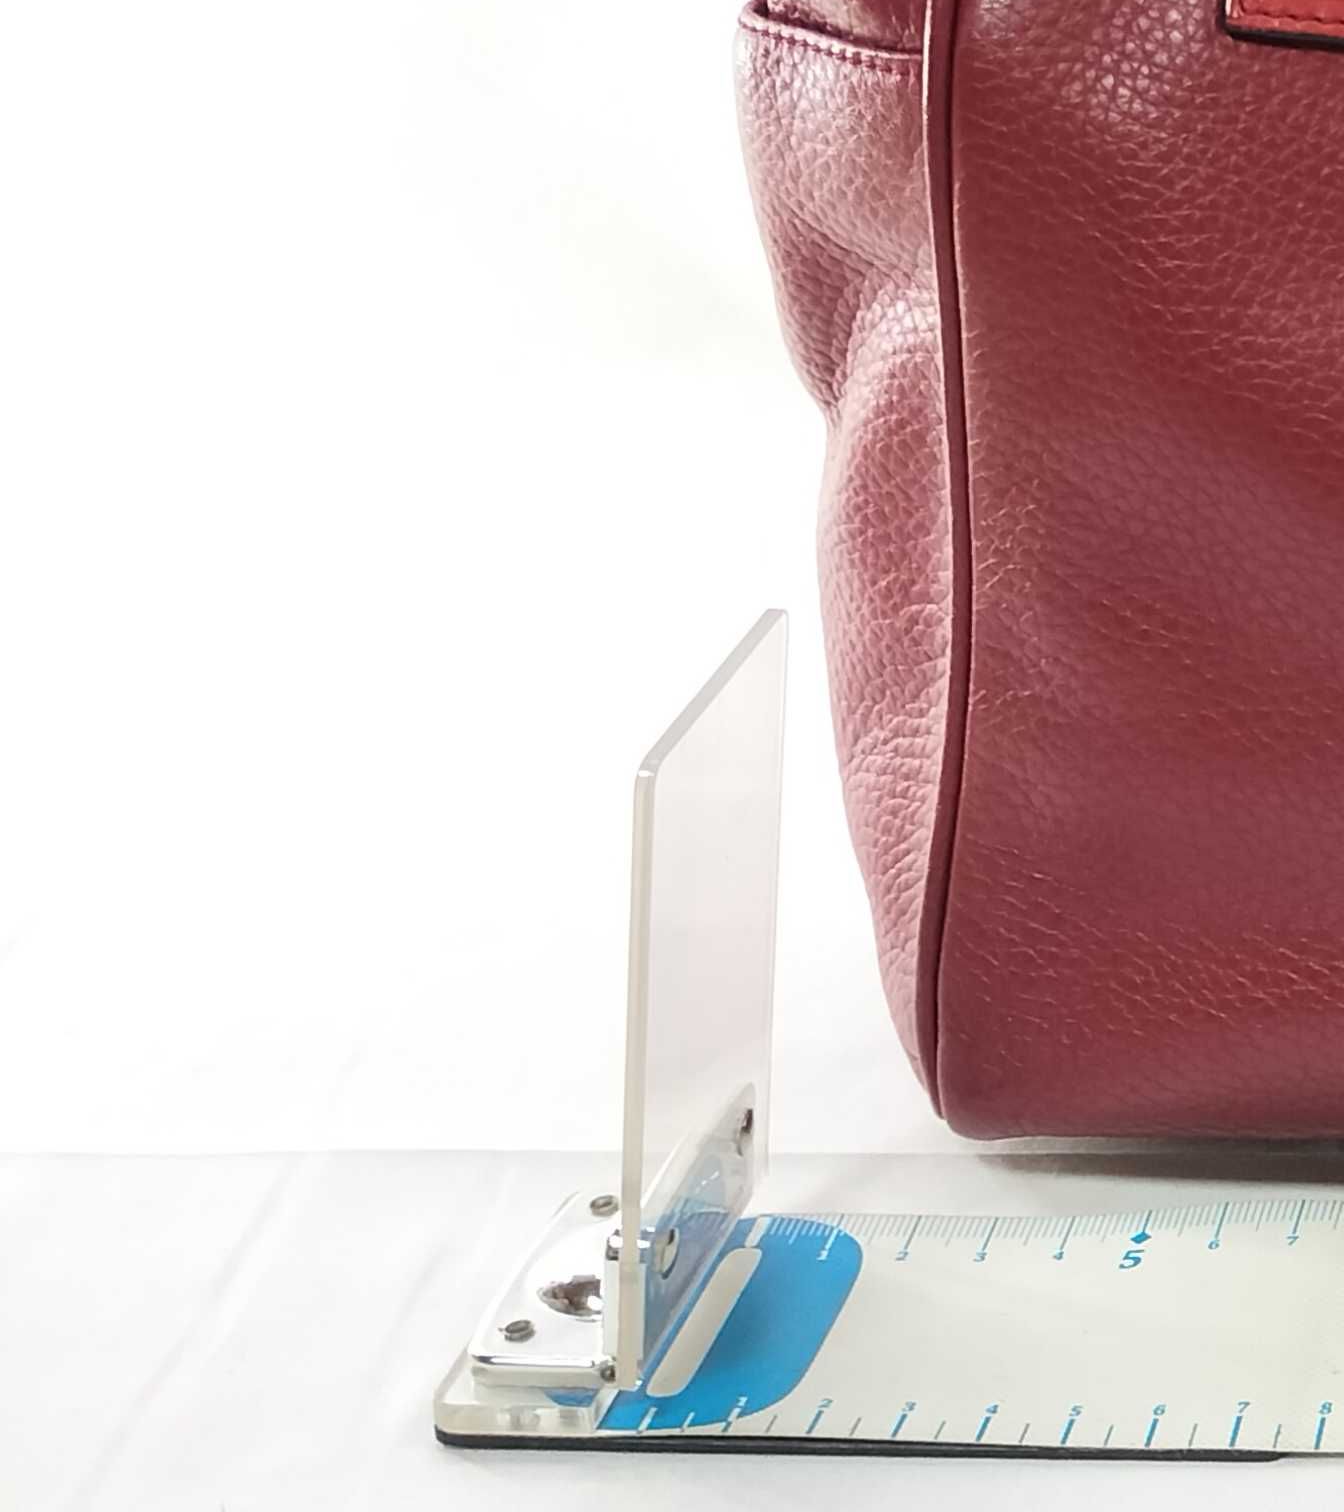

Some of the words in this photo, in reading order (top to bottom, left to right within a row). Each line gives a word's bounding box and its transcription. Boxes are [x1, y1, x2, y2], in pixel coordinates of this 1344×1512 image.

[896, 1251, 909, 1261] 2
[973, 1253, 986, 1263] 3
[1053, 1250, 1065, 1261] 4
[1118, 1249, 1145, 1269] 5
[1208, 1239, 1220, 1250] 6
[1287, 1236, 1299, 1246] 7
[818, 1398, 834, 1409] 2
[901, 1401, 917, 1412] 3
[986, 1404, 999, 1414] 4
[1069, 1406, 1083, 1417] 5
[1153, 1404, 1166, 1416] 6
[1237, 1402, 1250, 1414] 7
[1319, 1402, 1332, 1414] 8
